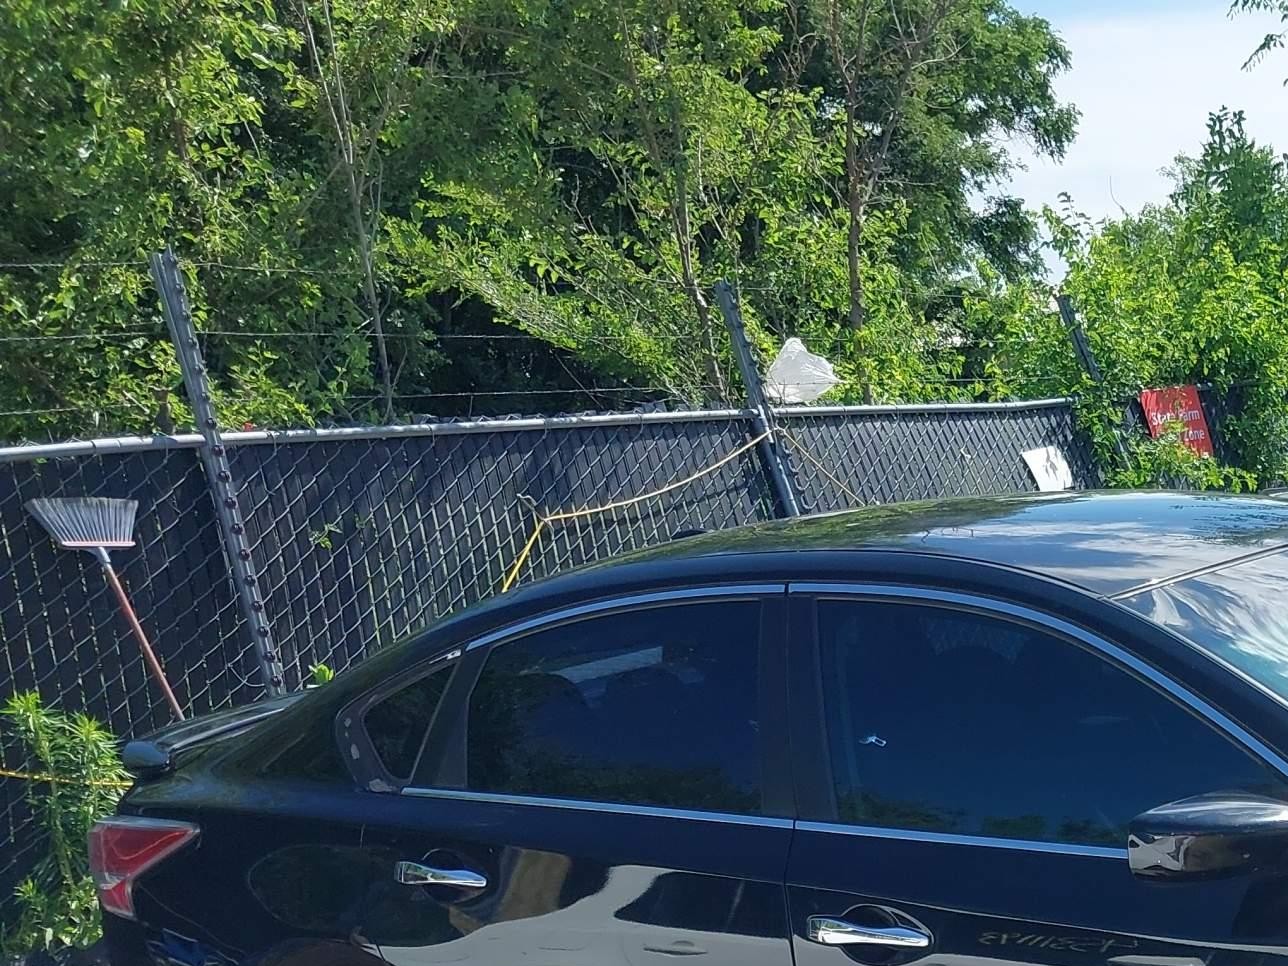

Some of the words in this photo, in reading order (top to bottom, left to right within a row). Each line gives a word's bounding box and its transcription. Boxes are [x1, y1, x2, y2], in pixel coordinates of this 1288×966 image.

[1151, 411, 1176, 425] State
[1178, 409, 1200, 421] Farm
[1184, 429, 1205, 441] Zone
